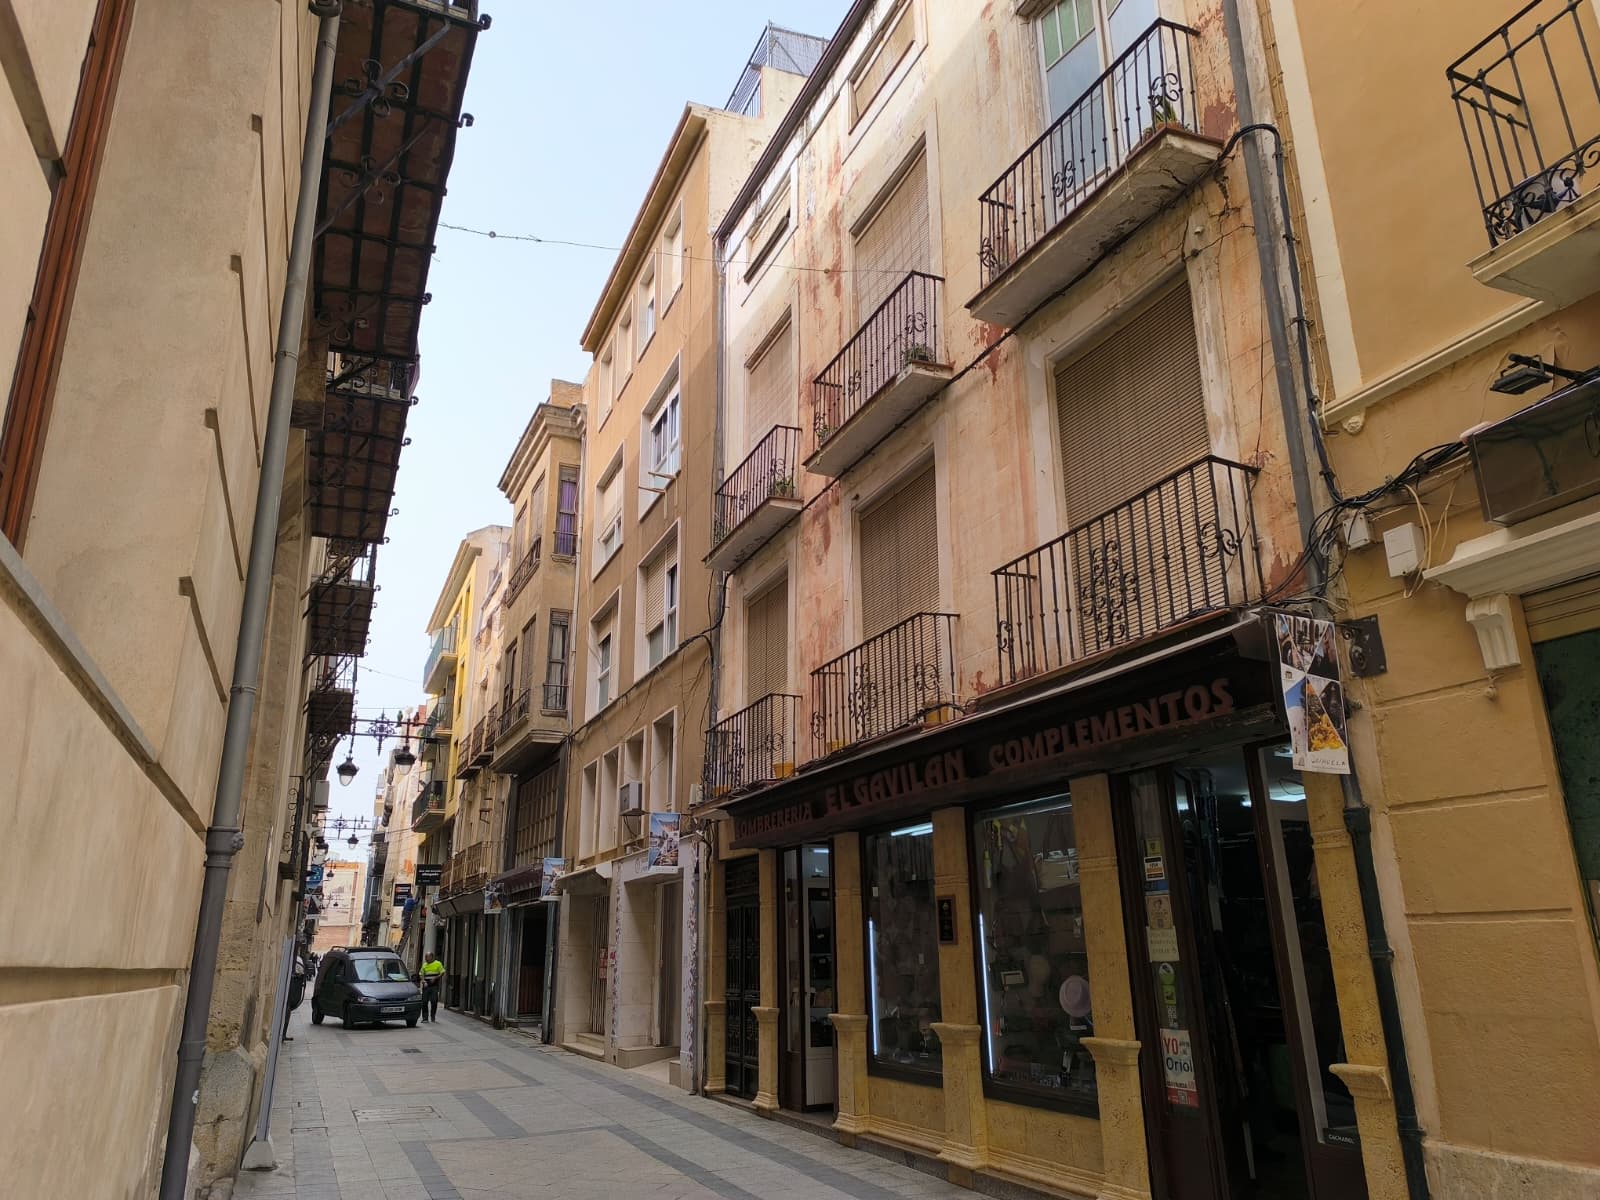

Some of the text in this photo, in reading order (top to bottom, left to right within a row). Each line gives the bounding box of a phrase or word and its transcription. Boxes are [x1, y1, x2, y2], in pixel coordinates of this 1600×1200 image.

[824, 783, 851, 815] EL
[853, 746, 966, 805] GAVILAN
[988, 677, 1234, 770] COMPLEMENTOS
[1163, 1038, 1179, 1056] YO
[1166, 1057, 1193, 1073] Oriol
